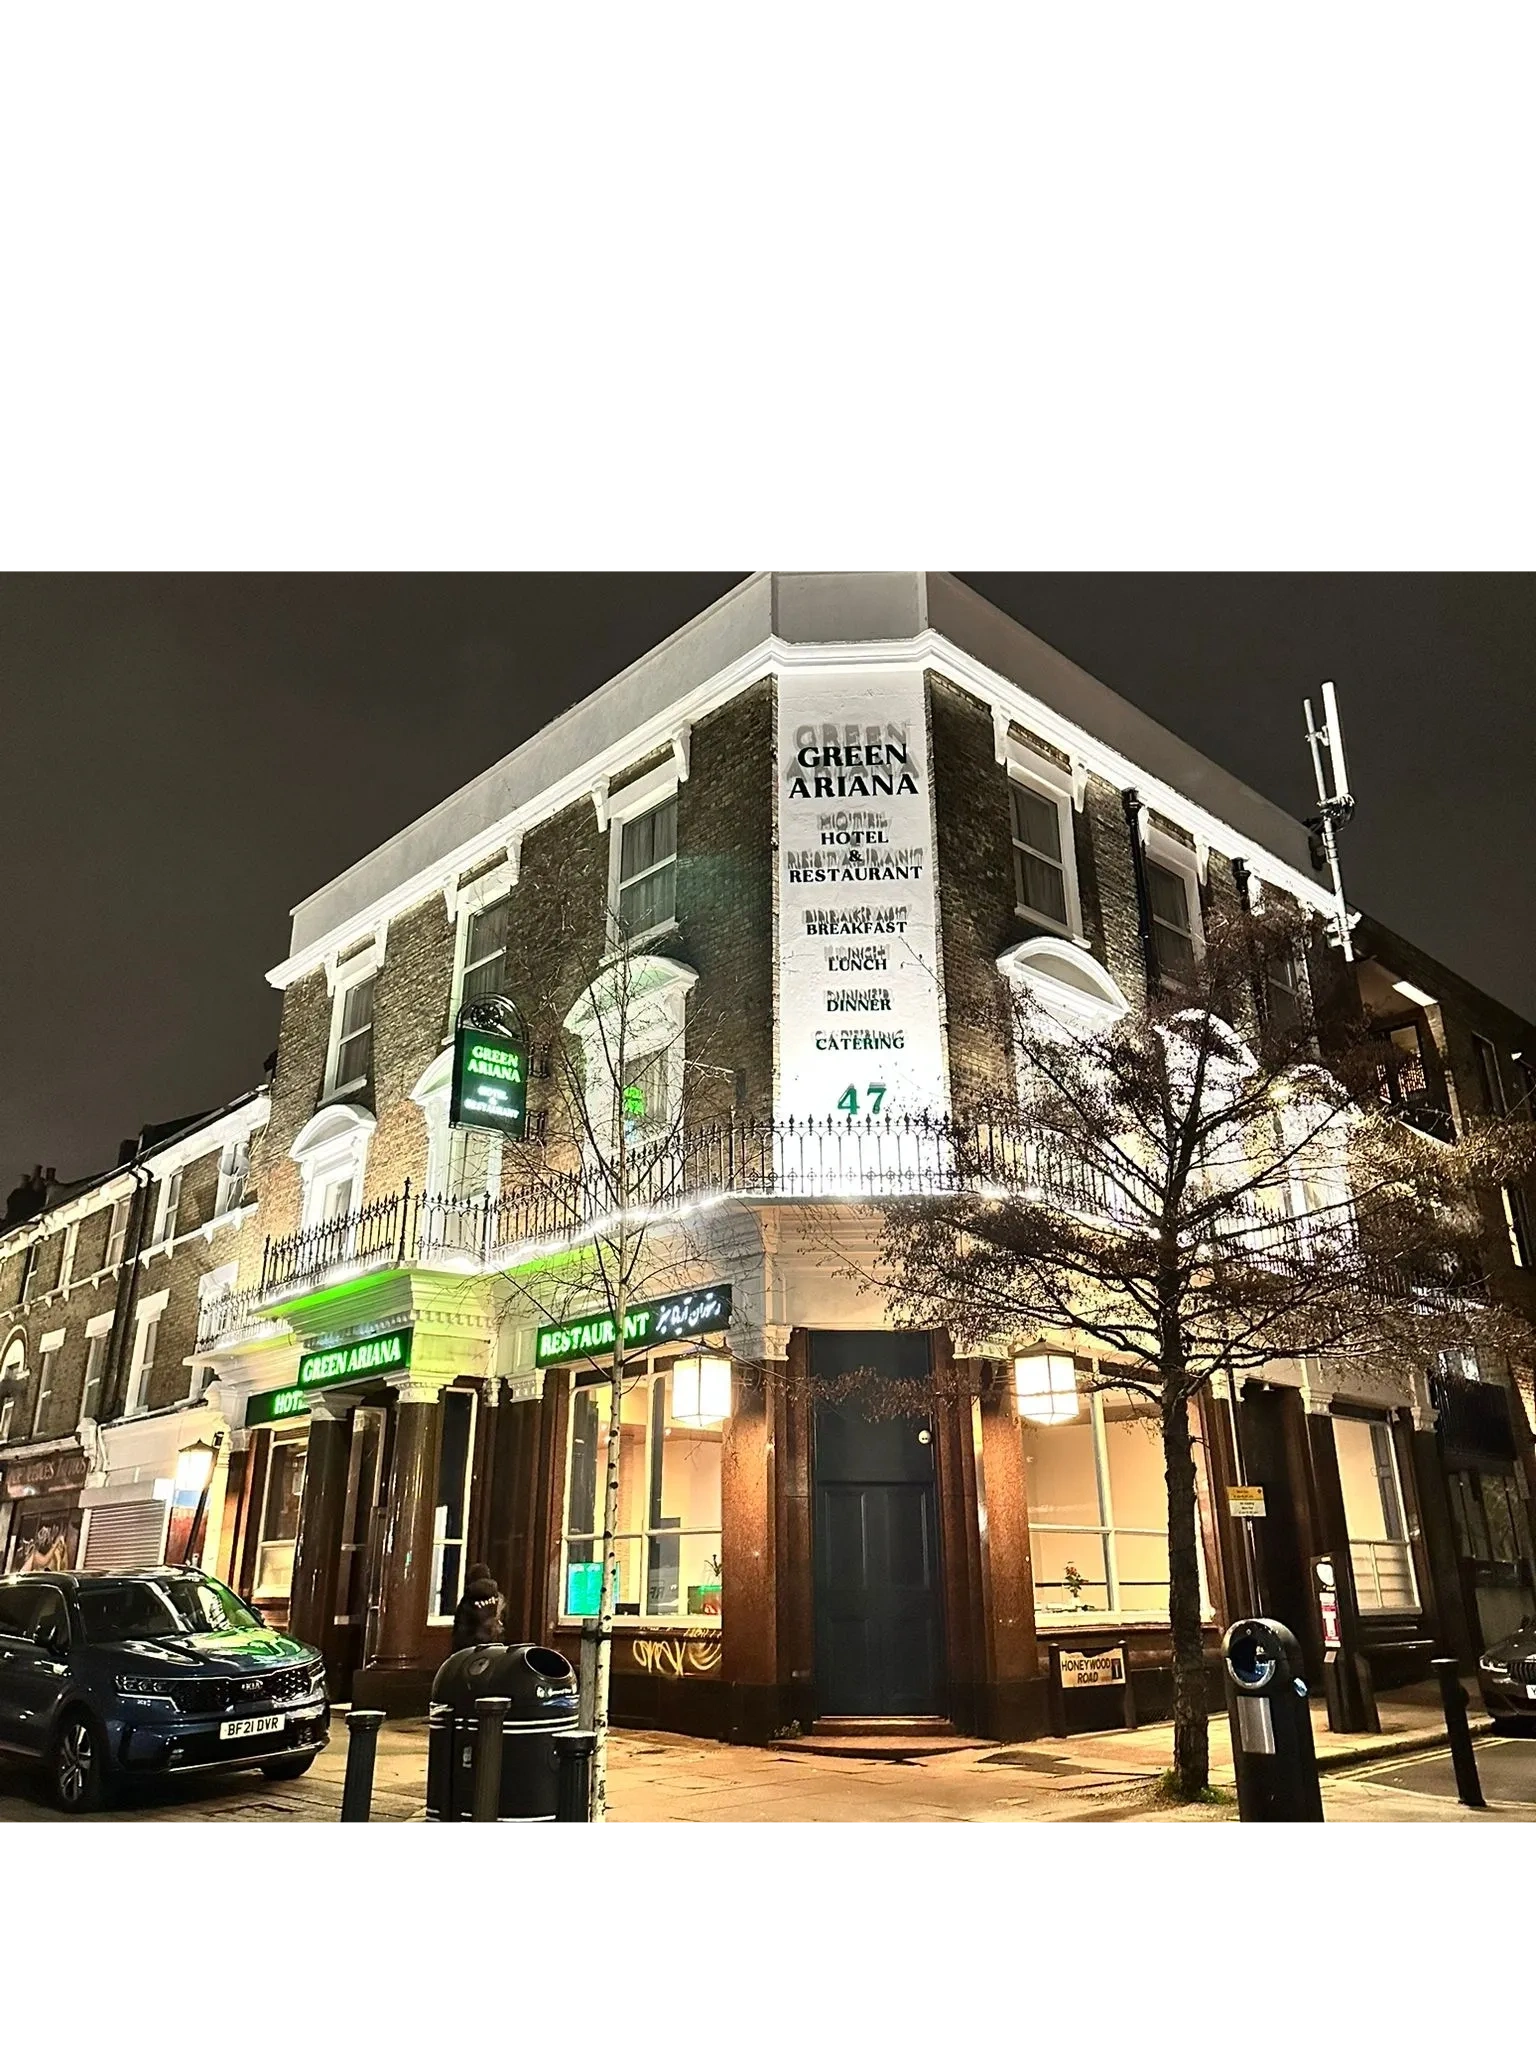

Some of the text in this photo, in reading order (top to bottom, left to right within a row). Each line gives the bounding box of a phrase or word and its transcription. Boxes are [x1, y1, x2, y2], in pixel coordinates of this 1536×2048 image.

[797, 743, 907, 768] GREEN
[788, 774, 919, 799] ARIANA
[821, 831, 889, 845] HOTEL
[849, 850, 863, 862] &
[789, 866, 923, 883] RESTAURANT
[806, 922, 907, 935] BREAKFAST
[828, 958, 887, 971] LUNCH
[827, 999, 891, 1012] DINNER
[815, 1037, 905, 1050] CATERING
[472, 1045, 519, 1068] GREEN
[467, 1058, 521, 1083] ARIANA
[837, 1085, 887, 1115] 47
[540, 1311, 650, 1357] RESTAURNT
[302, 1337, 402, 1383] GREEN ARIANA
[1061, 1658, 1111, 1671] HONEYWOOD
[1077, 1672, 1099, 1683] ROAD
[228, 1717, 278, 1736] BF21 DVR
